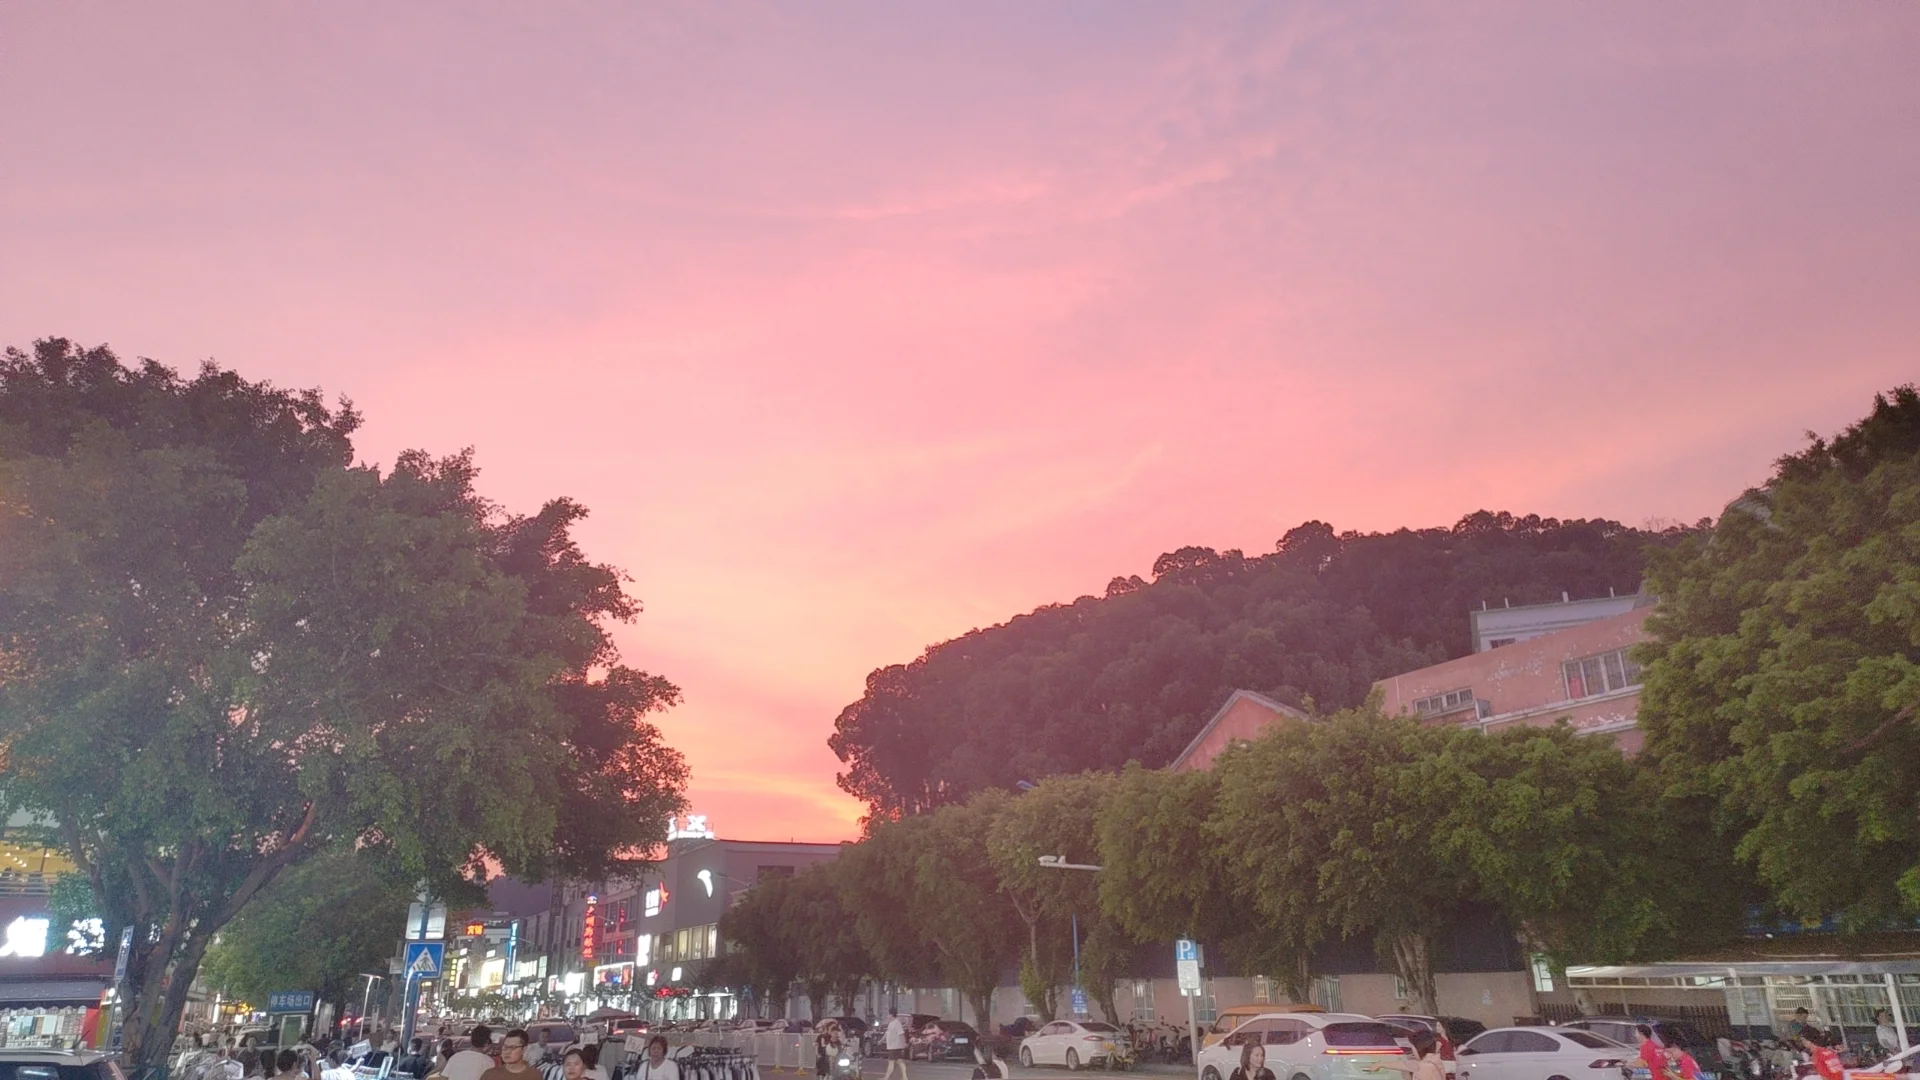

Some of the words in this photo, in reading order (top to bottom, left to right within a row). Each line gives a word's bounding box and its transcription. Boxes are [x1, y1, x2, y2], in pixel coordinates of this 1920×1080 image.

[1178, 940, 1191, 960] P
[270, 994, 311, 1008] 停车场出口
